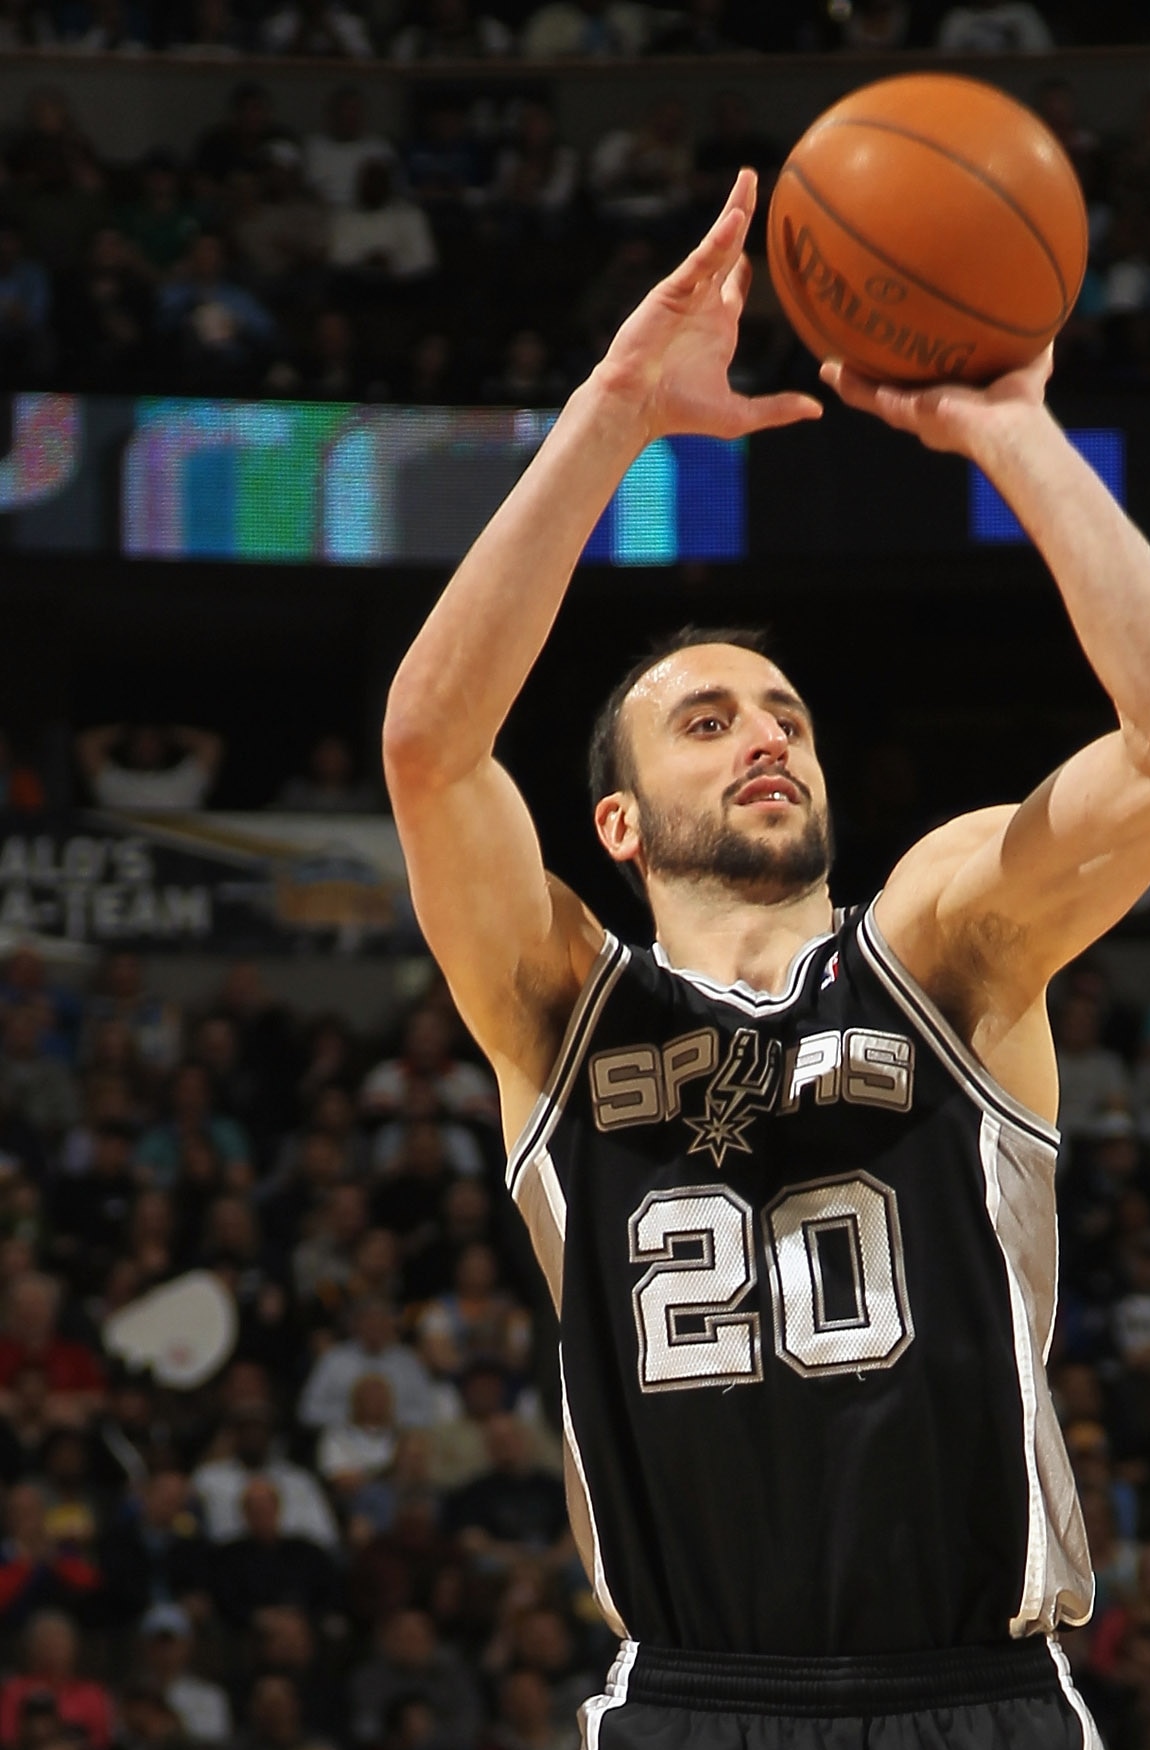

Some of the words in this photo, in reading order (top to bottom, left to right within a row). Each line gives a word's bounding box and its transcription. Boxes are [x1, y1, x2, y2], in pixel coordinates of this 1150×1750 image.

[792, 222, 977, 378] SPALDING
[589, 1027, 916, 1168] SPURS
[628, 1169, 916, 1393] 20
